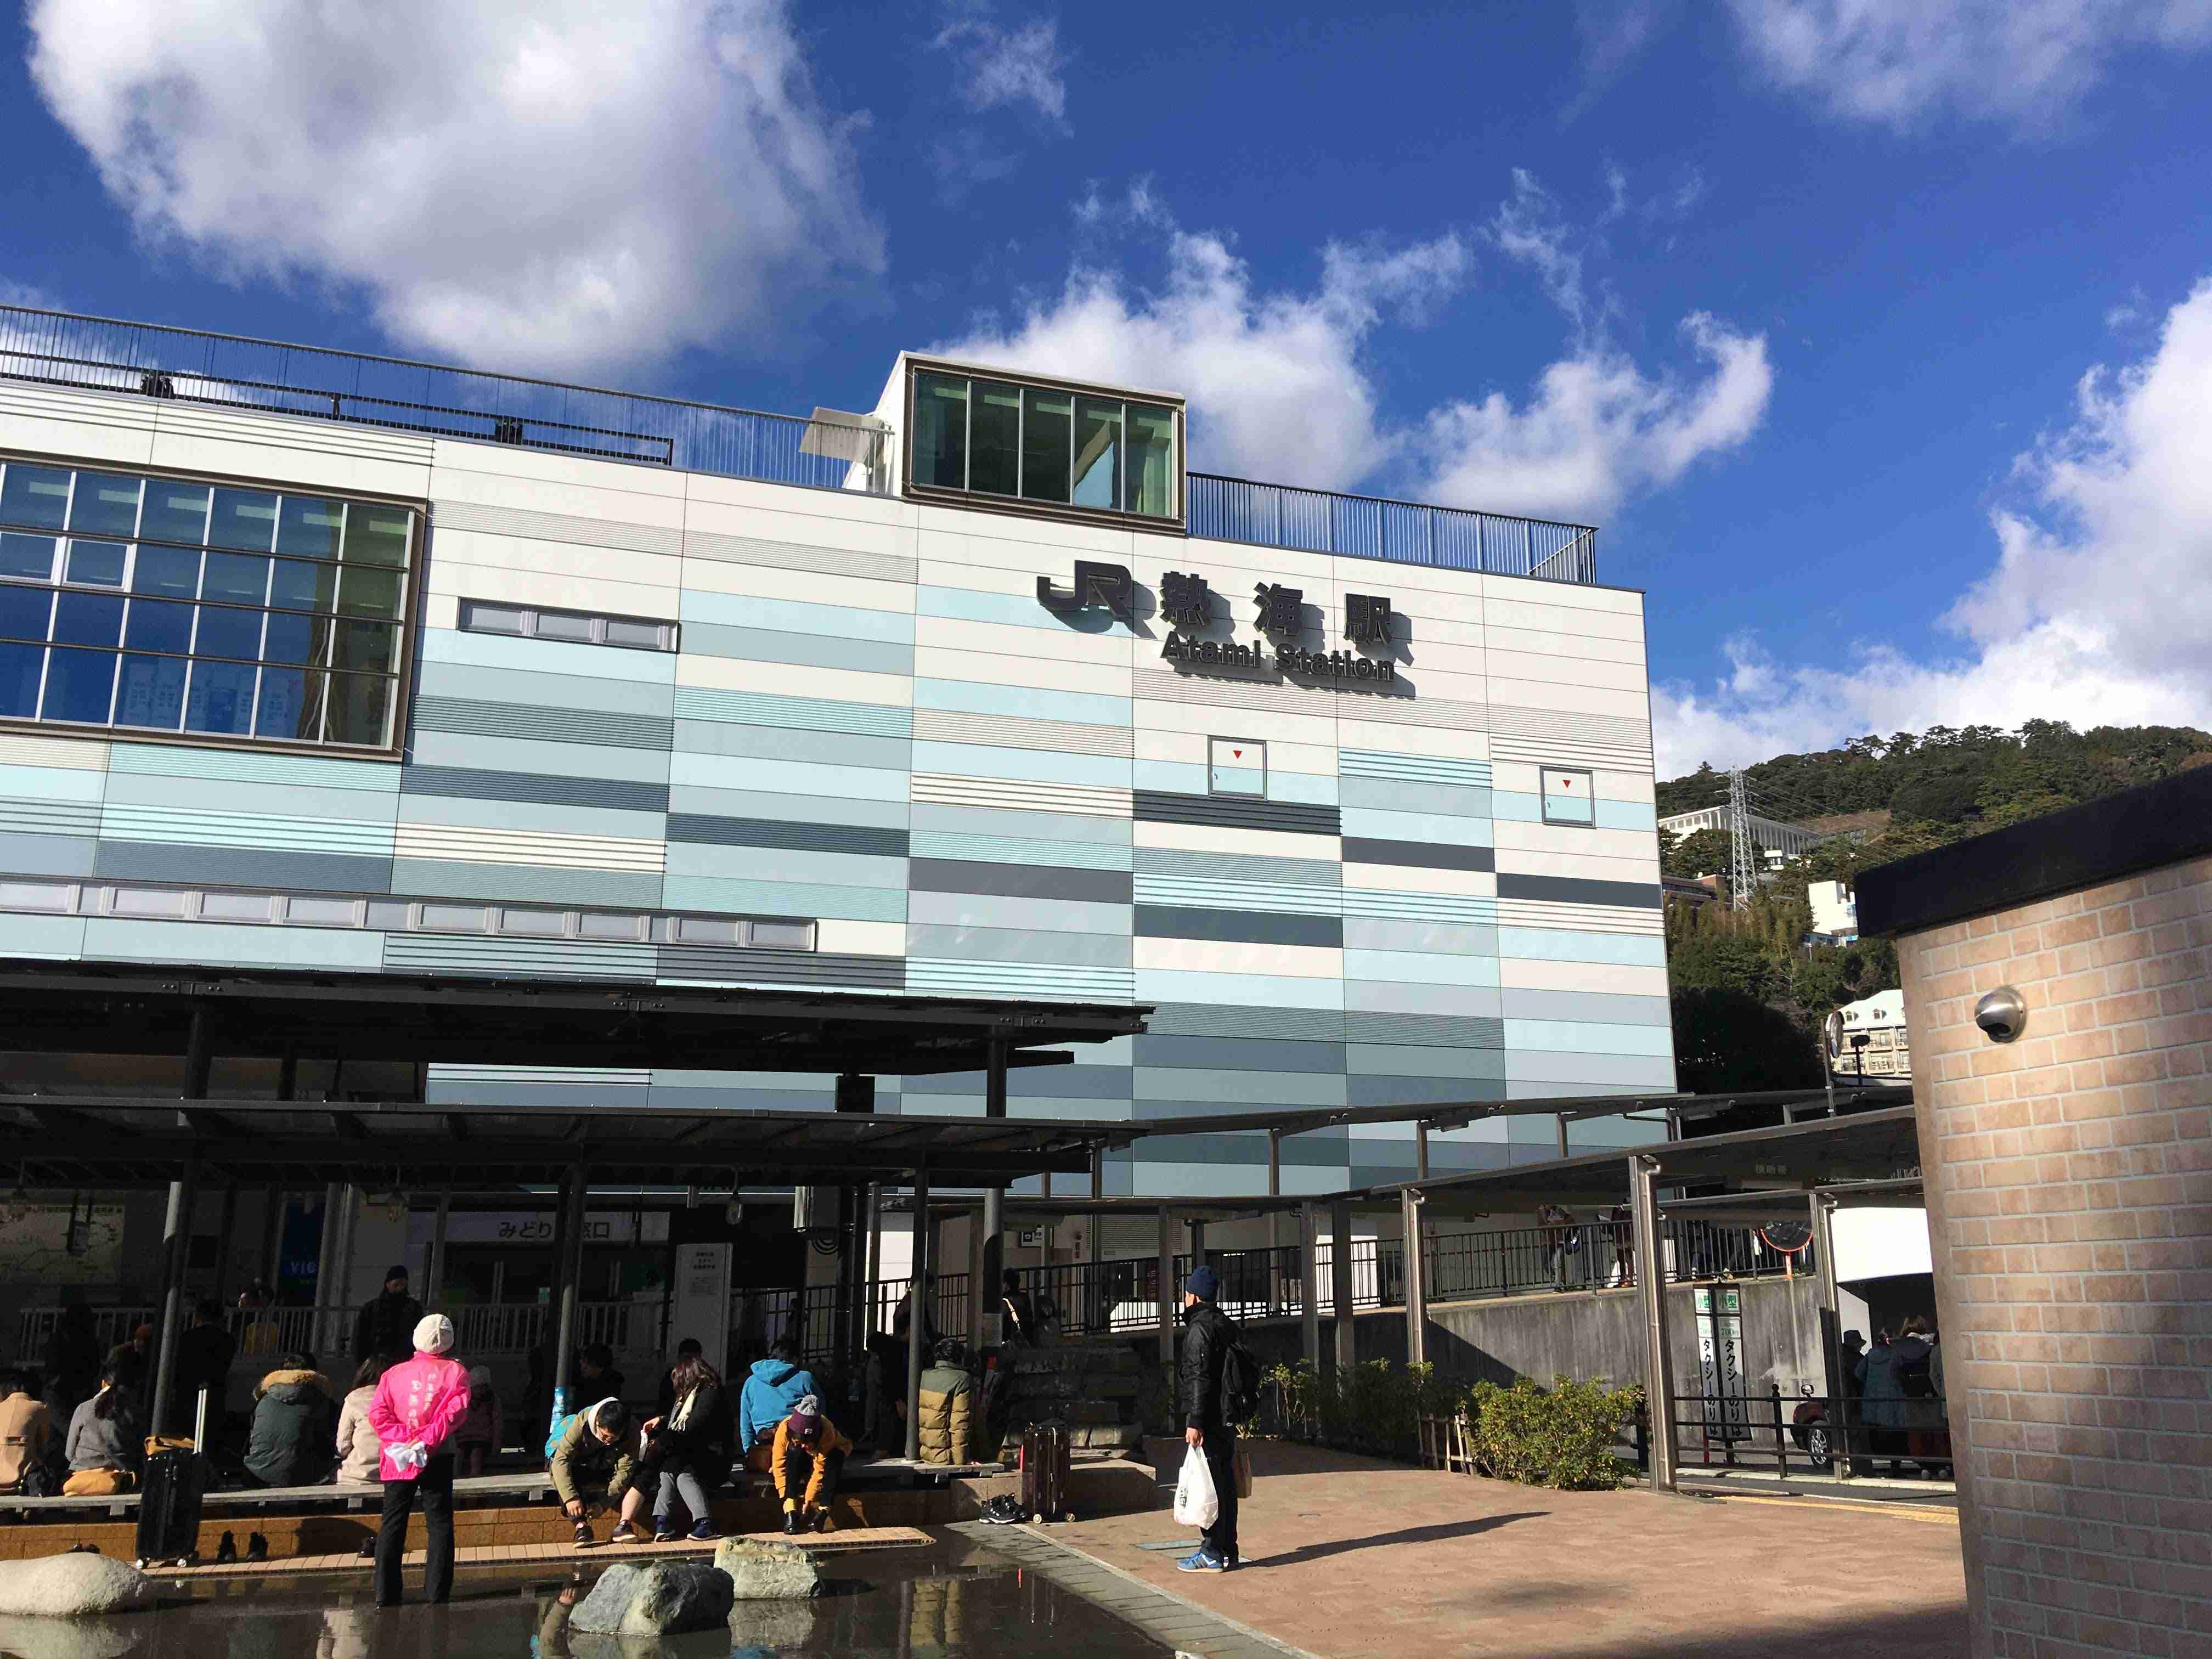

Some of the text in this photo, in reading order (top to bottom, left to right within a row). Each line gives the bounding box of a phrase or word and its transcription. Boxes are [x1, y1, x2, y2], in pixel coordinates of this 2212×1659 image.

[1036, 560, 1132, 622] JR
[1160, 631, 1395, 681] Atami Station
[1719, 1294, 1737, 1309] 小型
